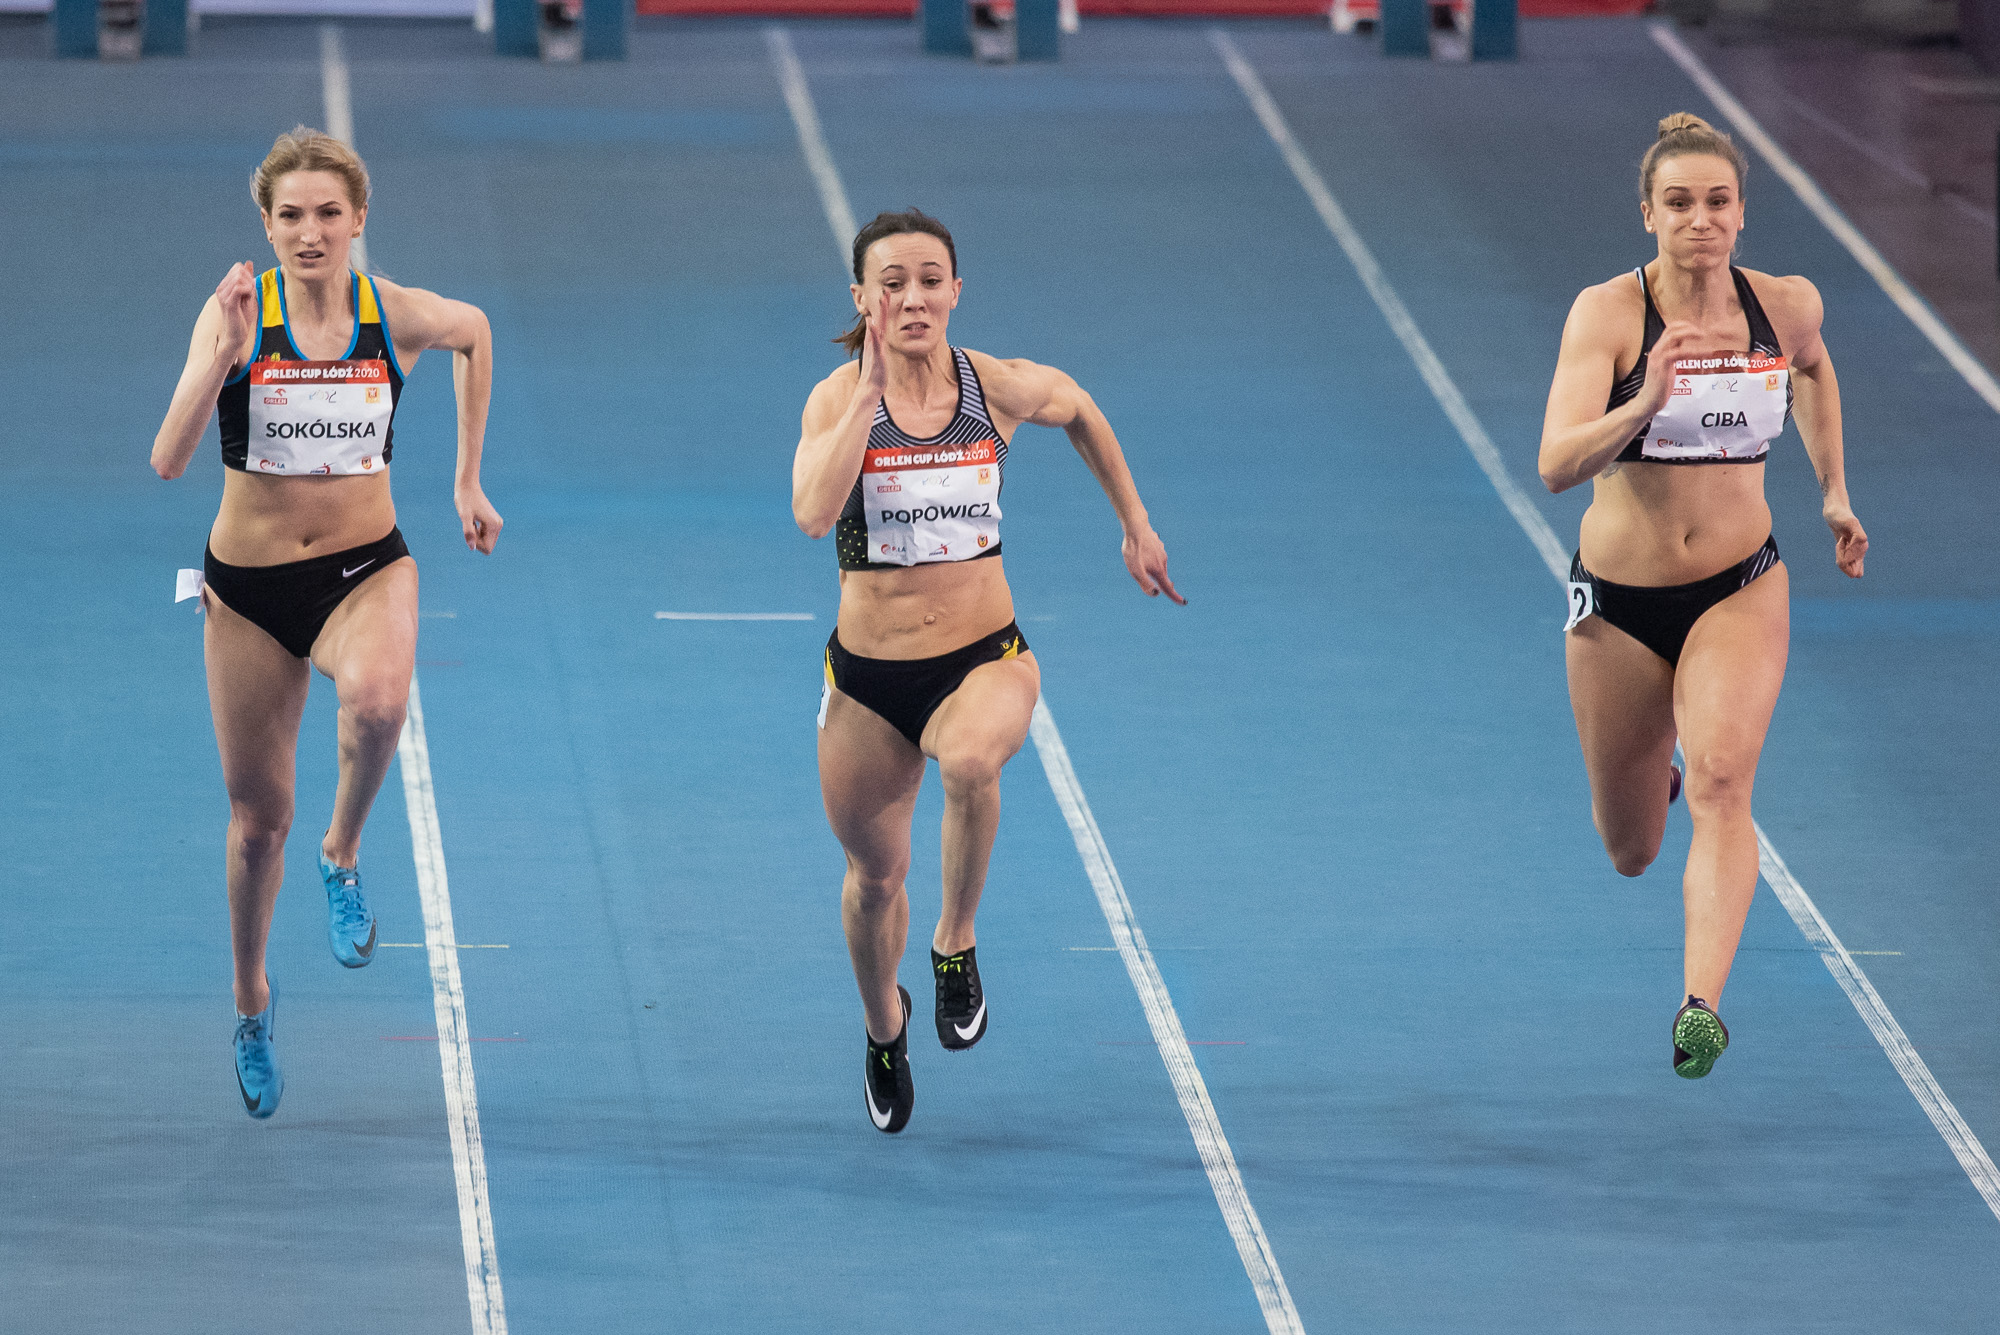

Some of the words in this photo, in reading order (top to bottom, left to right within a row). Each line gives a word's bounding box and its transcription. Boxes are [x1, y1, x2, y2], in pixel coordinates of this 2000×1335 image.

[1702, 358, 1723, 369] CUP
[1751, 357, 1776, 369] 2020
[263, 368, 300, 379] ORLEN
[301, 368, 320, 379] CUP
[354, 367, 380, 378] 2020
[1701, 411, 1748, 428] CIBA
[266, 419, 376, 439] SOKÓLSKA
[874, 454, 912, 467] ORLEN
[912, 452, 933, 464] CUP
[965, 448, 990, 461] 2020
[881, 502, 992, 524] POPOWICZ
